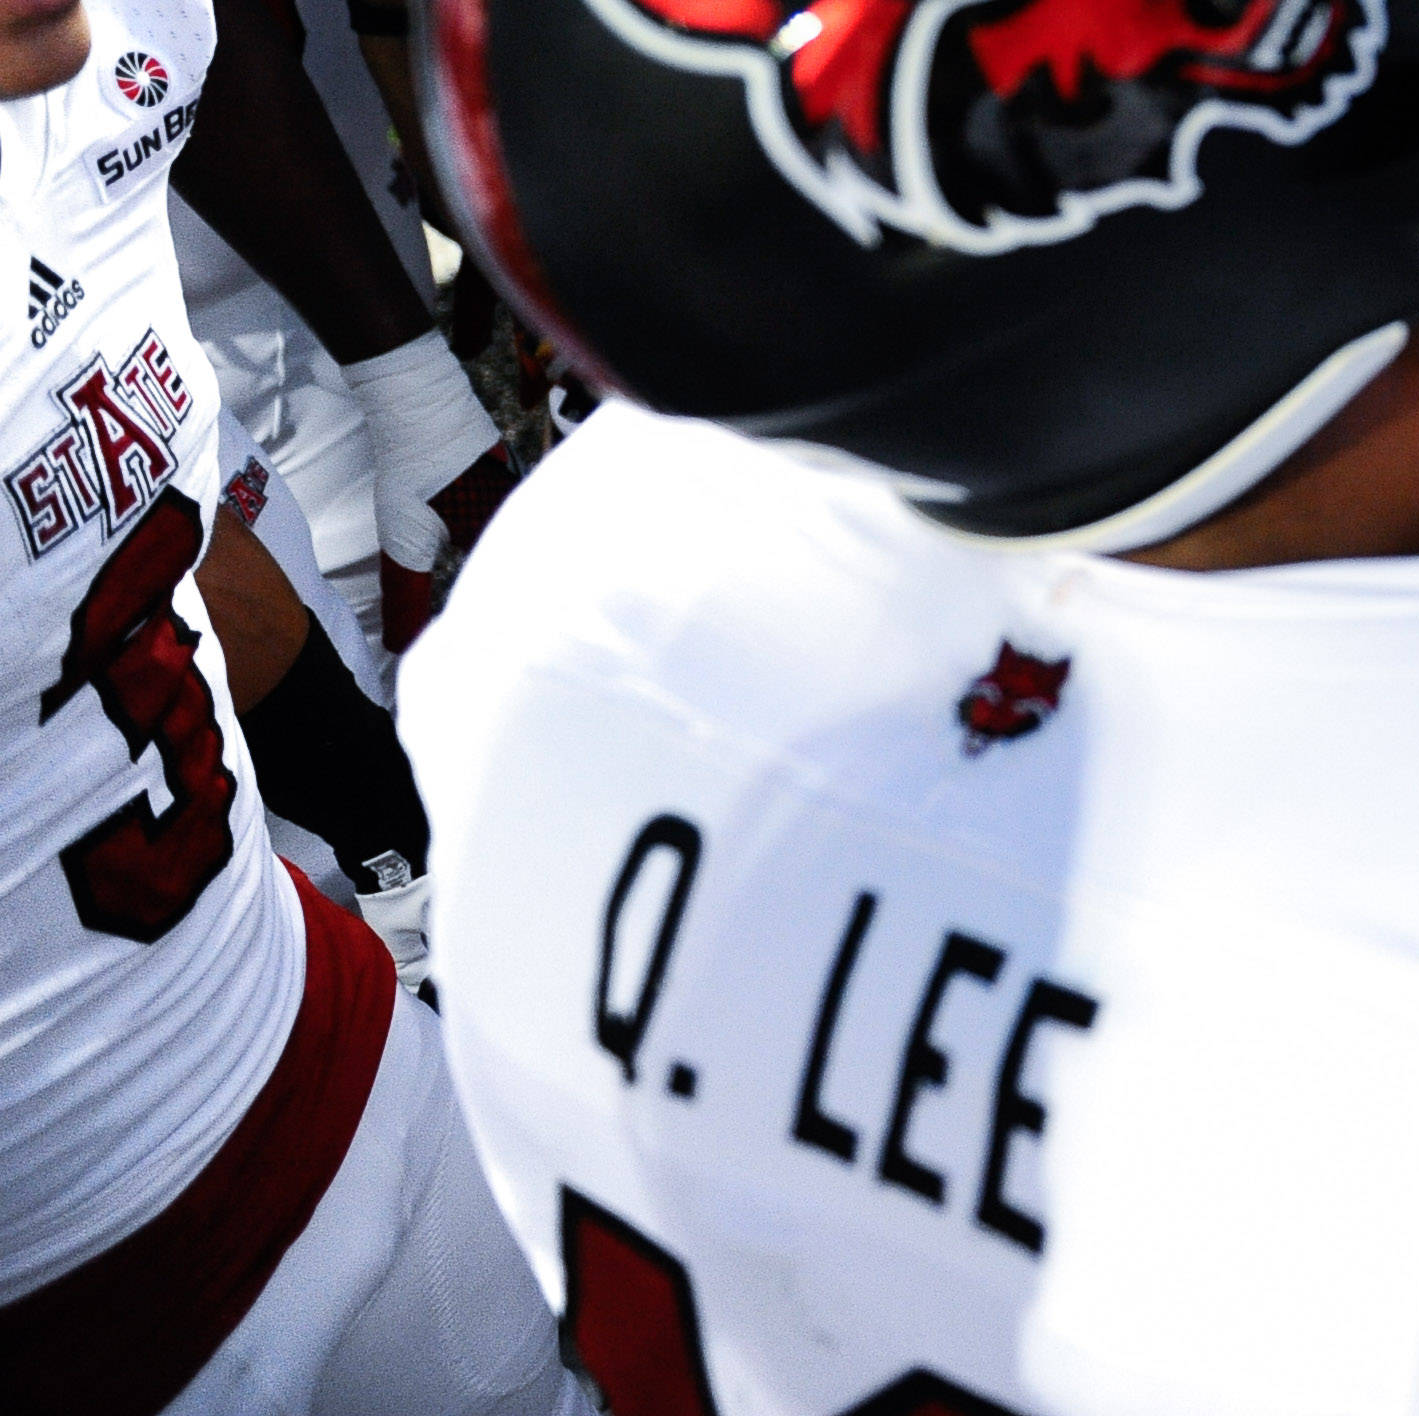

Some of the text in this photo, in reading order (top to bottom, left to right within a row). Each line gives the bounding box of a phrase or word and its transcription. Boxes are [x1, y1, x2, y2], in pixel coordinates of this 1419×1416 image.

[97, 128, 163, 187] SUN
[31, 278, 85, 350] adidas
[4, 327, 194, 561] STATE
[39, 484, 237, 945] 3
[592, 813, 1100, 1264] Q. LEE
